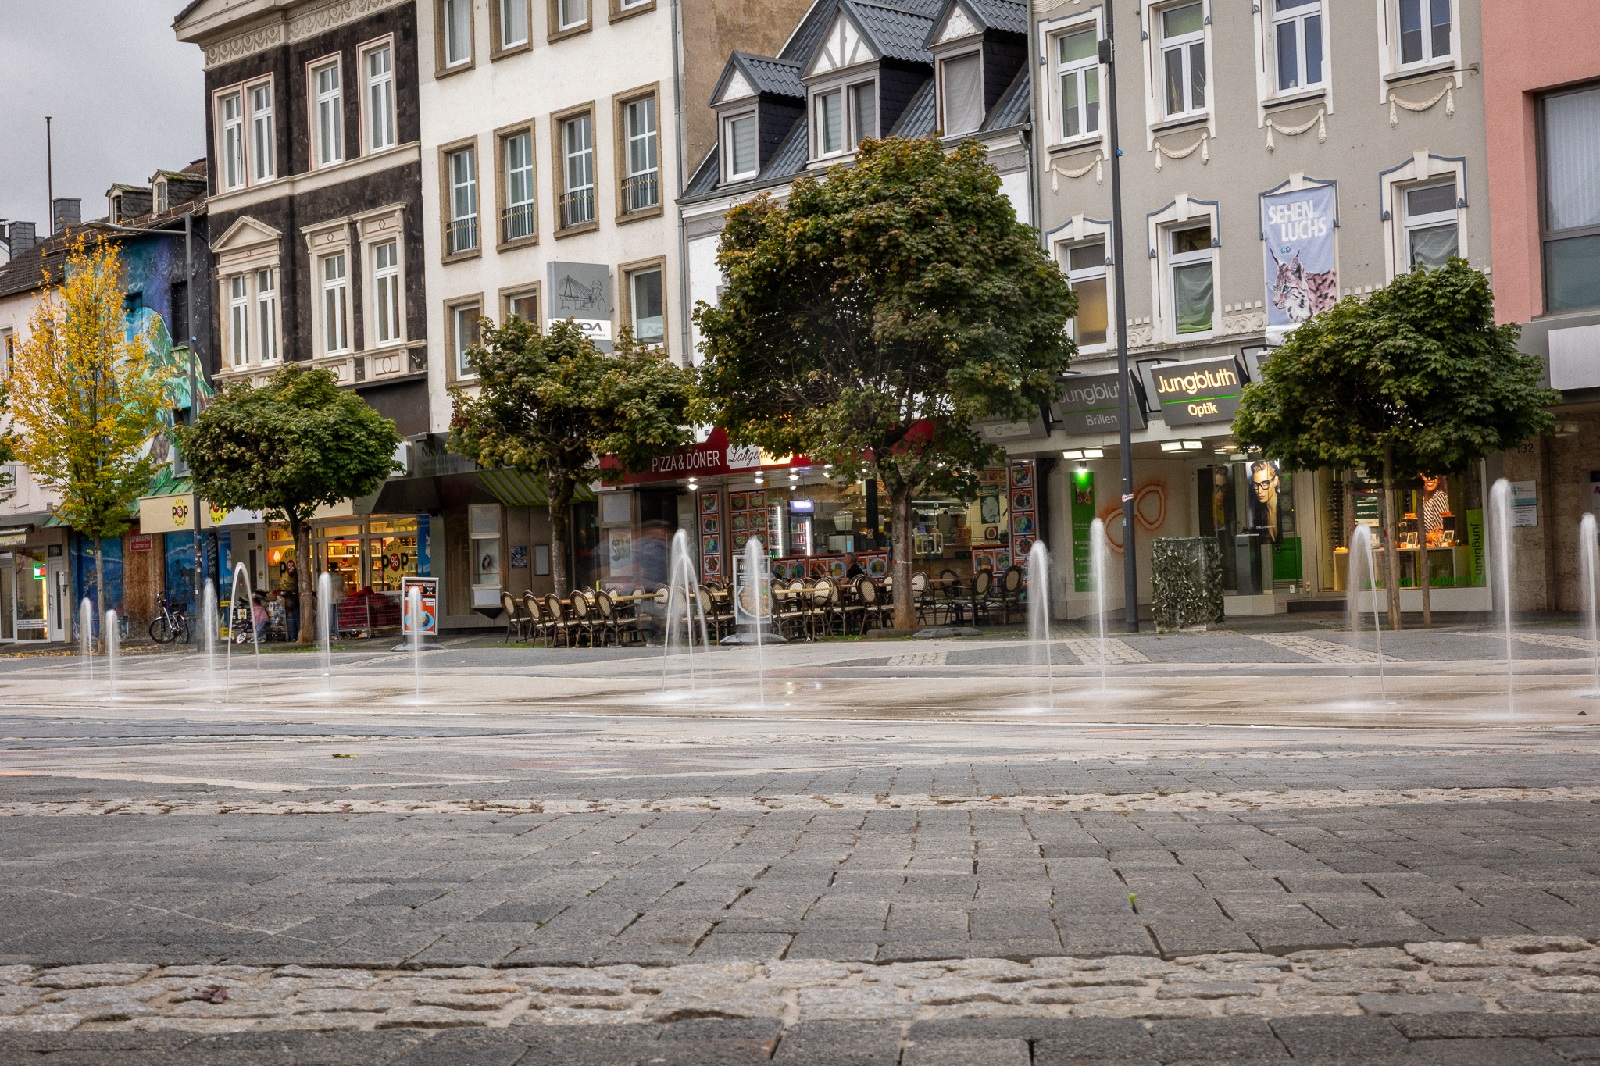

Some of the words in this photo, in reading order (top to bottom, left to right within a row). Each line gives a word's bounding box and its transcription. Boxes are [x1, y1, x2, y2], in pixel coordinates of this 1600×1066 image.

[1268, 200, 1313, 225] SEHEN
[1281, 217, 1327, 241] LUCHS
[1158, 368, 1238, 395] Jungbluth
[1086, 414, 1117, 427] Brillen
[1187, 402, 1219, 418] Optik
[651, 455, 677, 473] PIZZA
[678, 454, 685, 470] &
[686, 449, 721, 470] DÖNER
